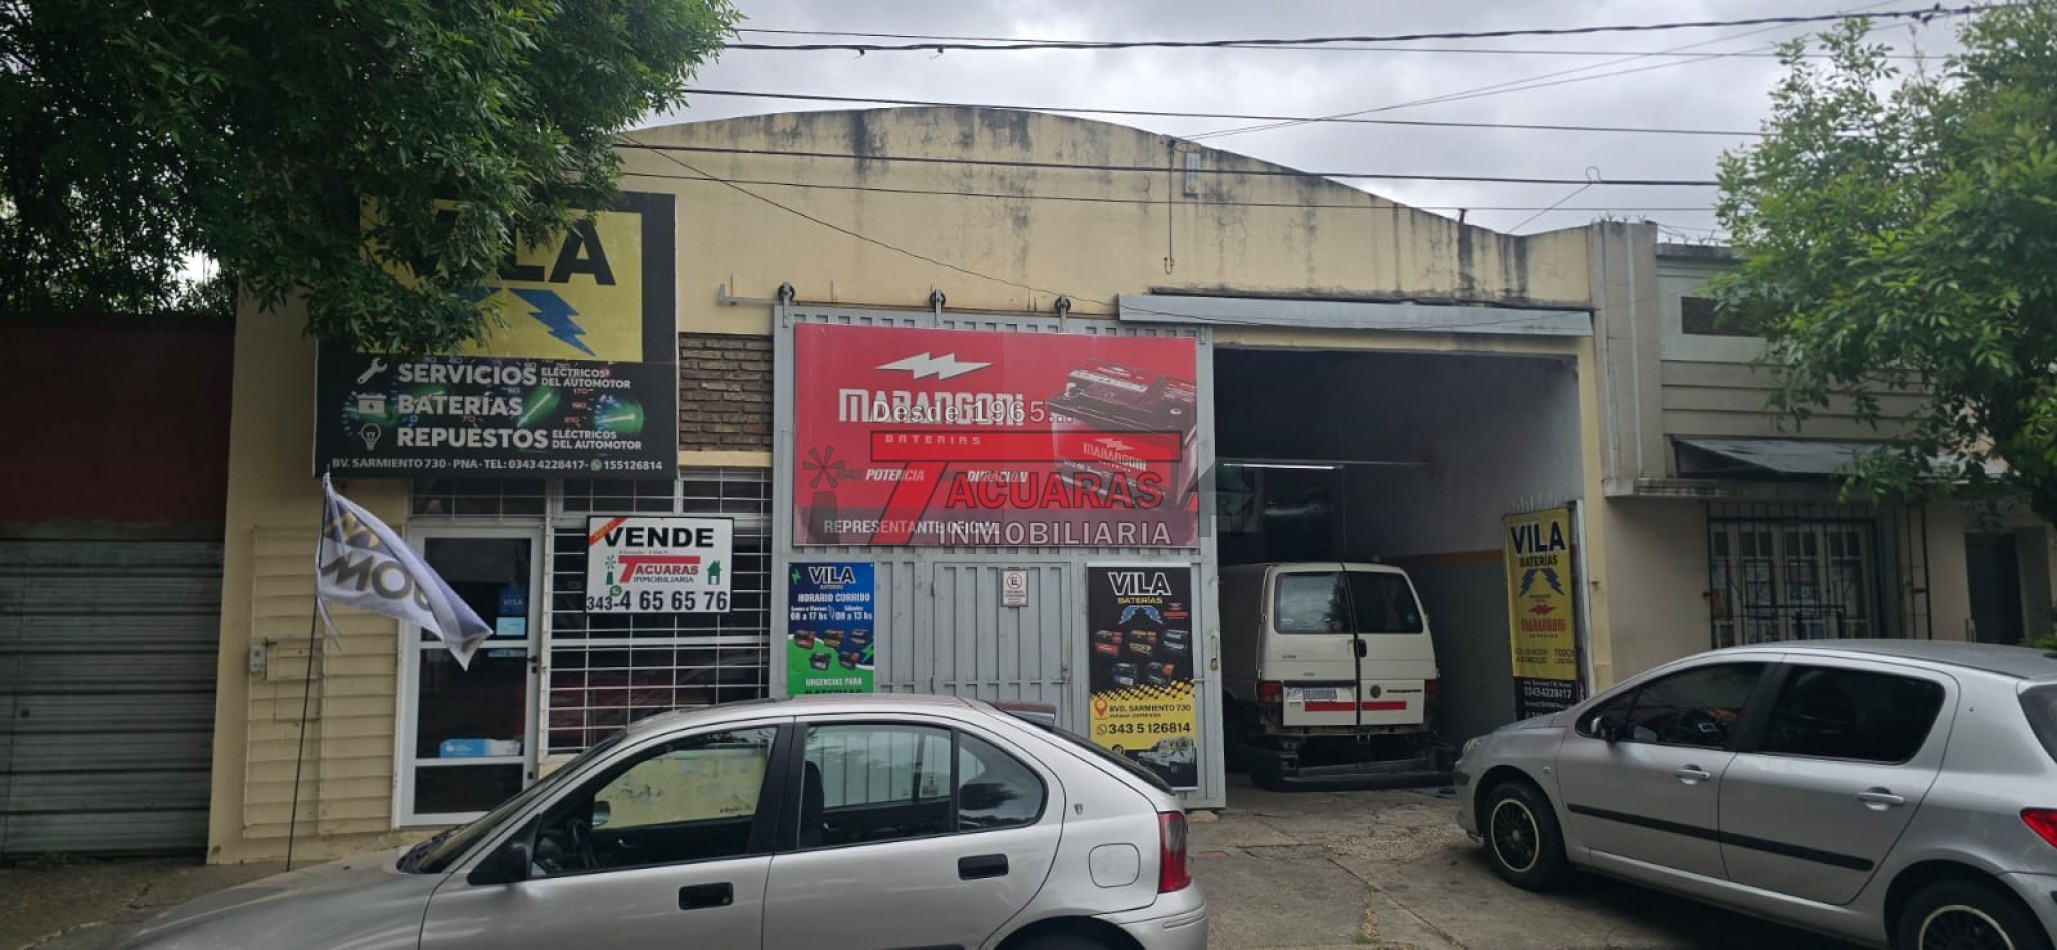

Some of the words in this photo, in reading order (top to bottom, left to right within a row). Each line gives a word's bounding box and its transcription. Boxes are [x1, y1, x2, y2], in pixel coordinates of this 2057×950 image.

[398, 362, 537, 386] SERVICIOS
[541, 378, 560, 387] DEL
[563, 379, 631, 389] AUTOMOTOR
[398, 391, 523, 415] BATERÍAS
[397, 427, 549, 449] REPUESTOS
[552, 440, 574, 449] DEL
[575, 440, 642, 450] AUTOMOTOR
[352, 458, 424, 468] SARMIENTO
[424, 458, 446, 468] 730
[453, 459, 478, 469] PNA
[484, 459, 507, 469] TEL:
[865, 468, 925, 482] POTENCIA
[604, 527, 715, 548] VENDE
[1510, 520, 1567, 555] VILA
[618, 555, 701, 583] TACUARAS
[808, 566, 856, 584] VILA
[1107, 571, 1172, 596] VILA
[503, 598, 524, 606] VISA
[639, 590, 664, 611] 65
[671, 590, 696, 611] 65
[703, 590, 728, 611] 76
[797, 593, 834, 603] HORARIO
[835, 593, 870, 602] CORRIDO
[1129, 703, 1174, 712] SARMIENTO
[1177, 704, 1191, 712] 730
[1109, 723, 1133, 734] 343
